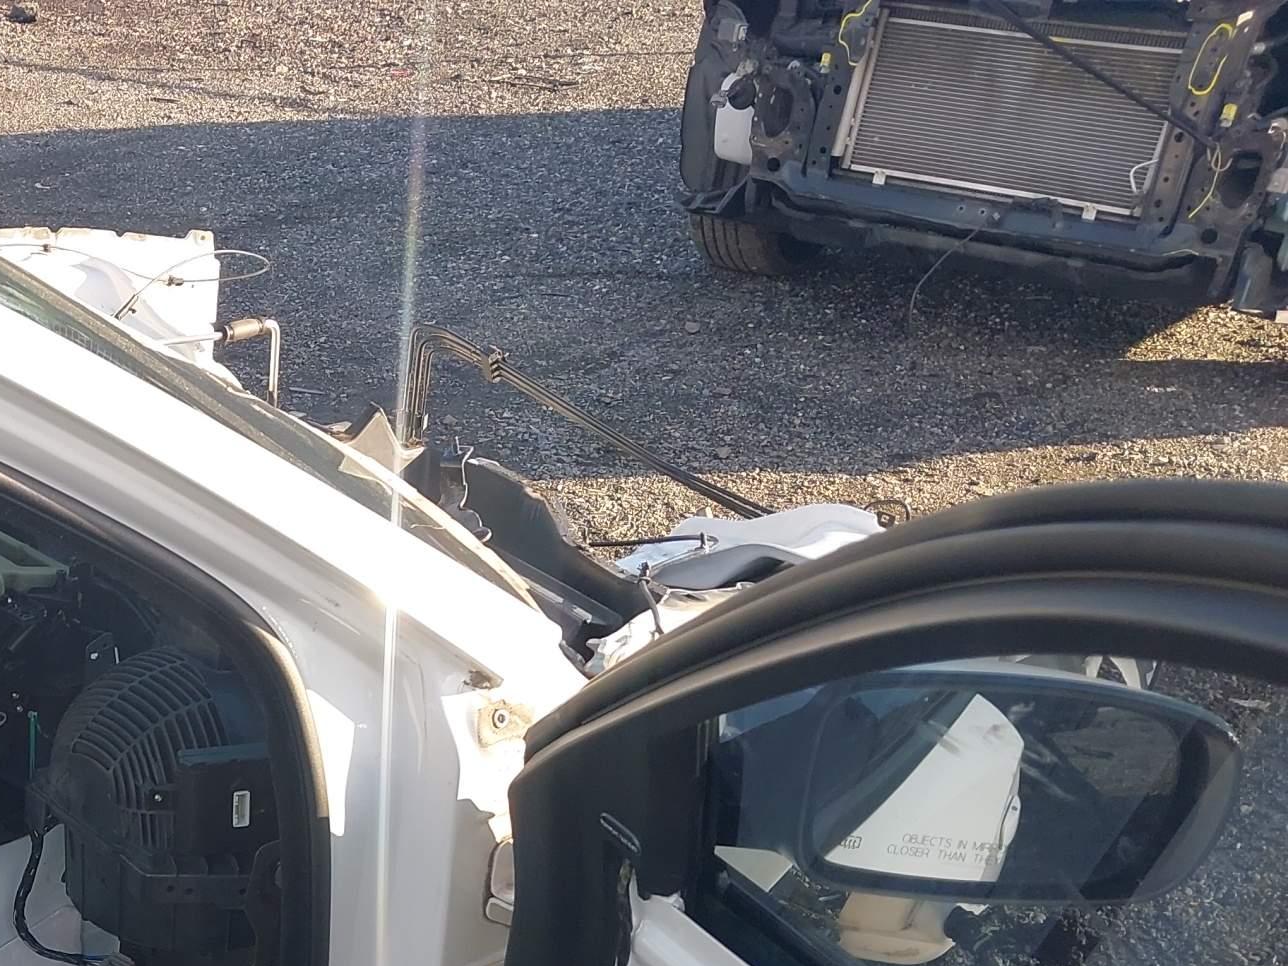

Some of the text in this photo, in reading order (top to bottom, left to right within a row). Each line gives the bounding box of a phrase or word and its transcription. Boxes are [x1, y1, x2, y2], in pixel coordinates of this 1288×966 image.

[902, 833, 953, 849] OBJECTS
[957, 839, 969, 850] IN
[886, 843, 930, 858] CLOSER
[938, 849, 967, 862] THAN
